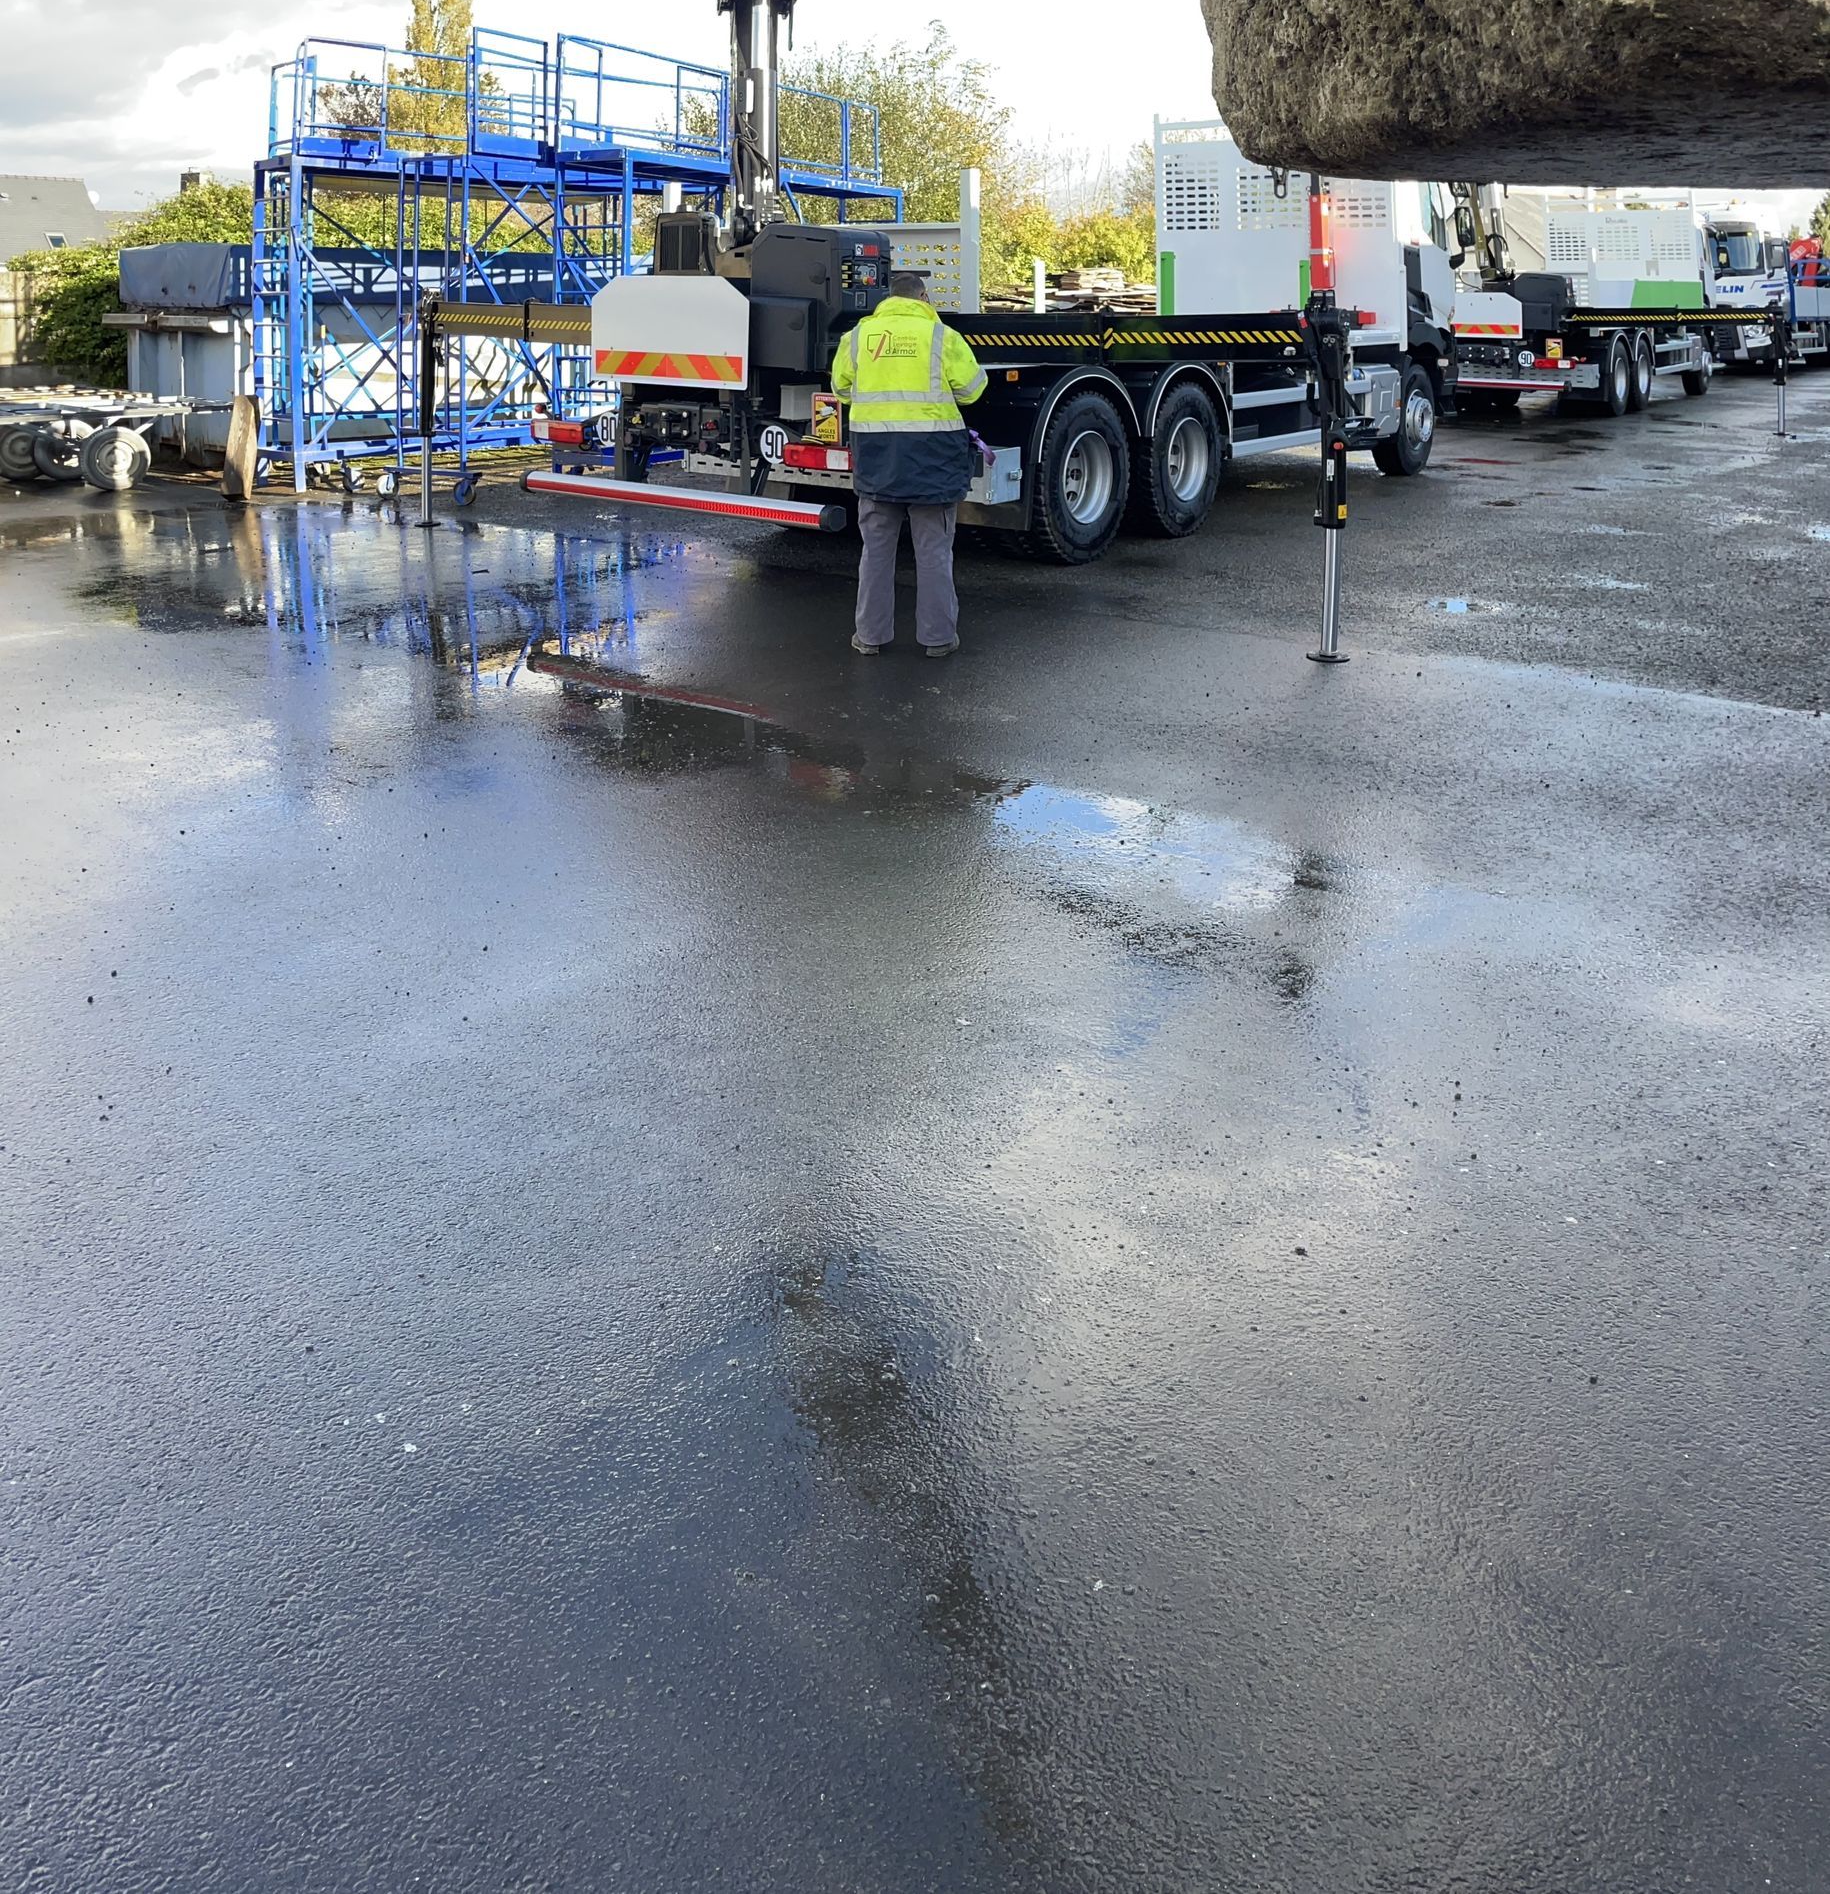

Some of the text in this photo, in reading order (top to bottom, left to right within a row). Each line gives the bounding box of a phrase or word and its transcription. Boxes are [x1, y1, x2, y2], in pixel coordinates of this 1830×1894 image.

[1520, 352, 1532, 365] 90
[601, 416, 616, 442] 80
[765, 429, 784, 459] 90
